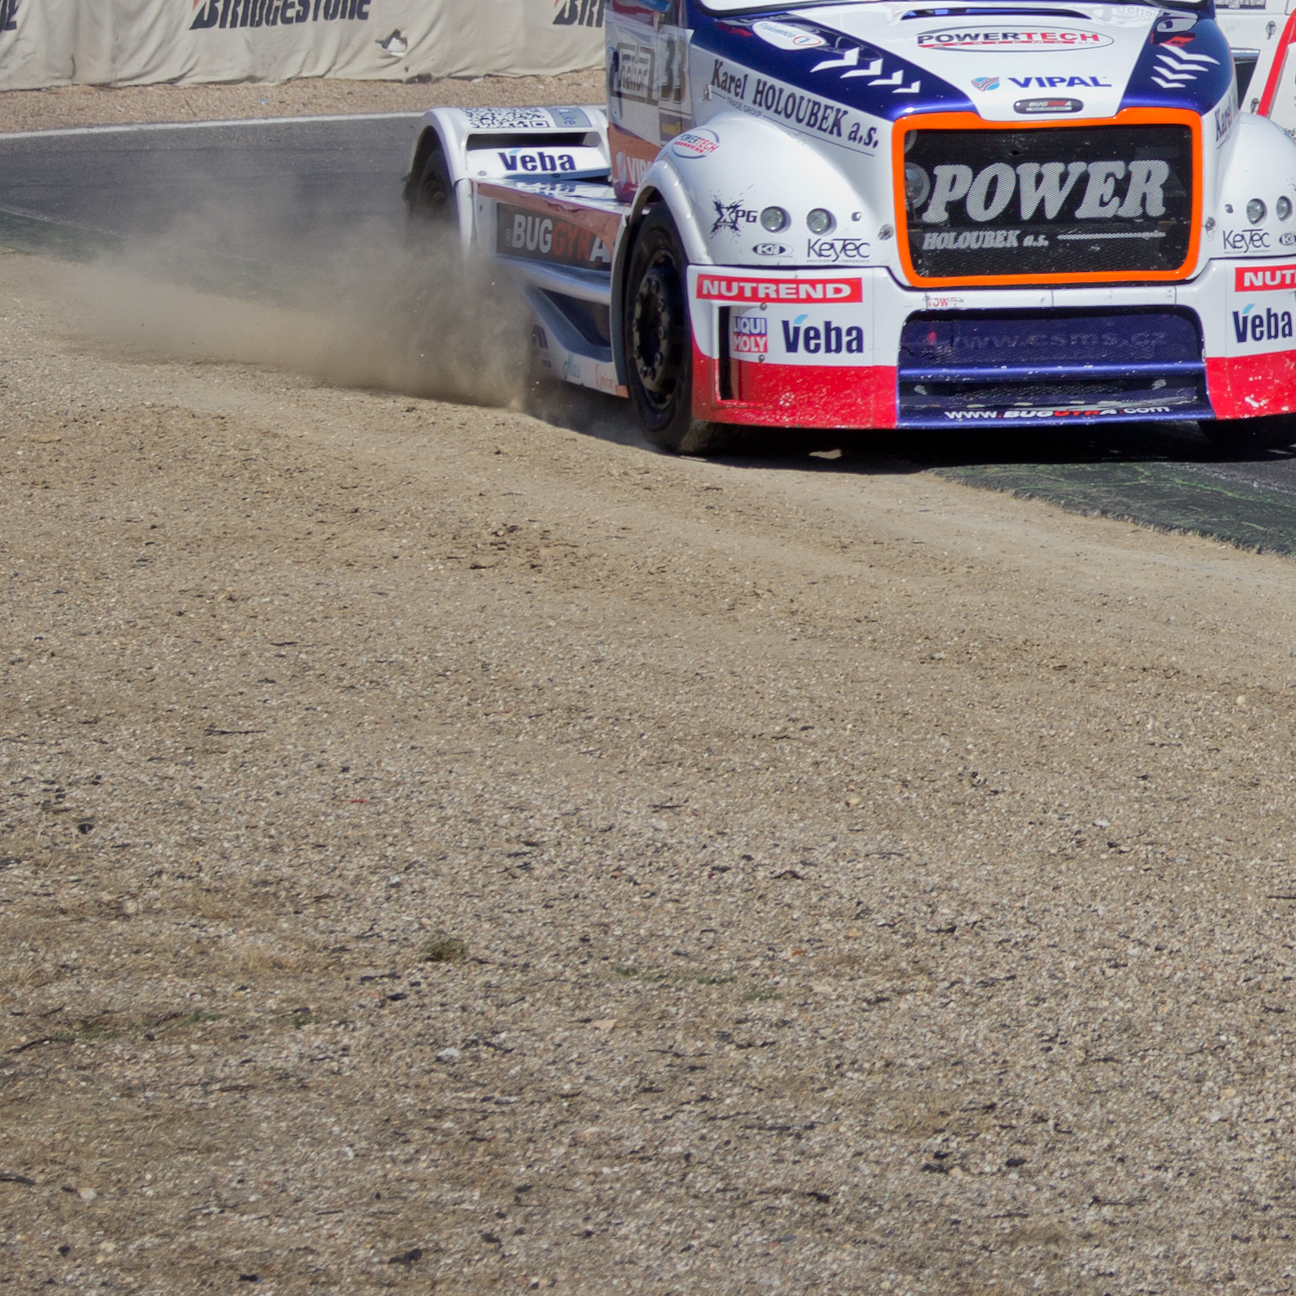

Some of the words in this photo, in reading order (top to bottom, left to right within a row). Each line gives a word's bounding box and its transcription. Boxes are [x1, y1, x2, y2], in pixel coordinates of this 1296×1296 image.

[917, 31, 1101, 45] POWERTECH
[1007, 76, 1113, 88] VIPAL
[711, 59, 749, 100] Karel
[752, 78, 849, 138] HOLOUBEK
[848, 120, 879, 149] a.s.
[498, 151, 577, 172] Veba
[921, 159, 1170, 224] POWER
[512, 214, 611, 264] BUGGYRA
[922, 230, 1022, 251] HOLOUBEK
[1022, 234, 1050, 248] a.s.
[702, 280, 852, 299] NUTREND
[733, 317, 767, 335] LIQUI
[781, 318, 864, 354] Veba
[1231, 307, 1293, 344] Veba
[733, 335, 767, 353] MOLY
